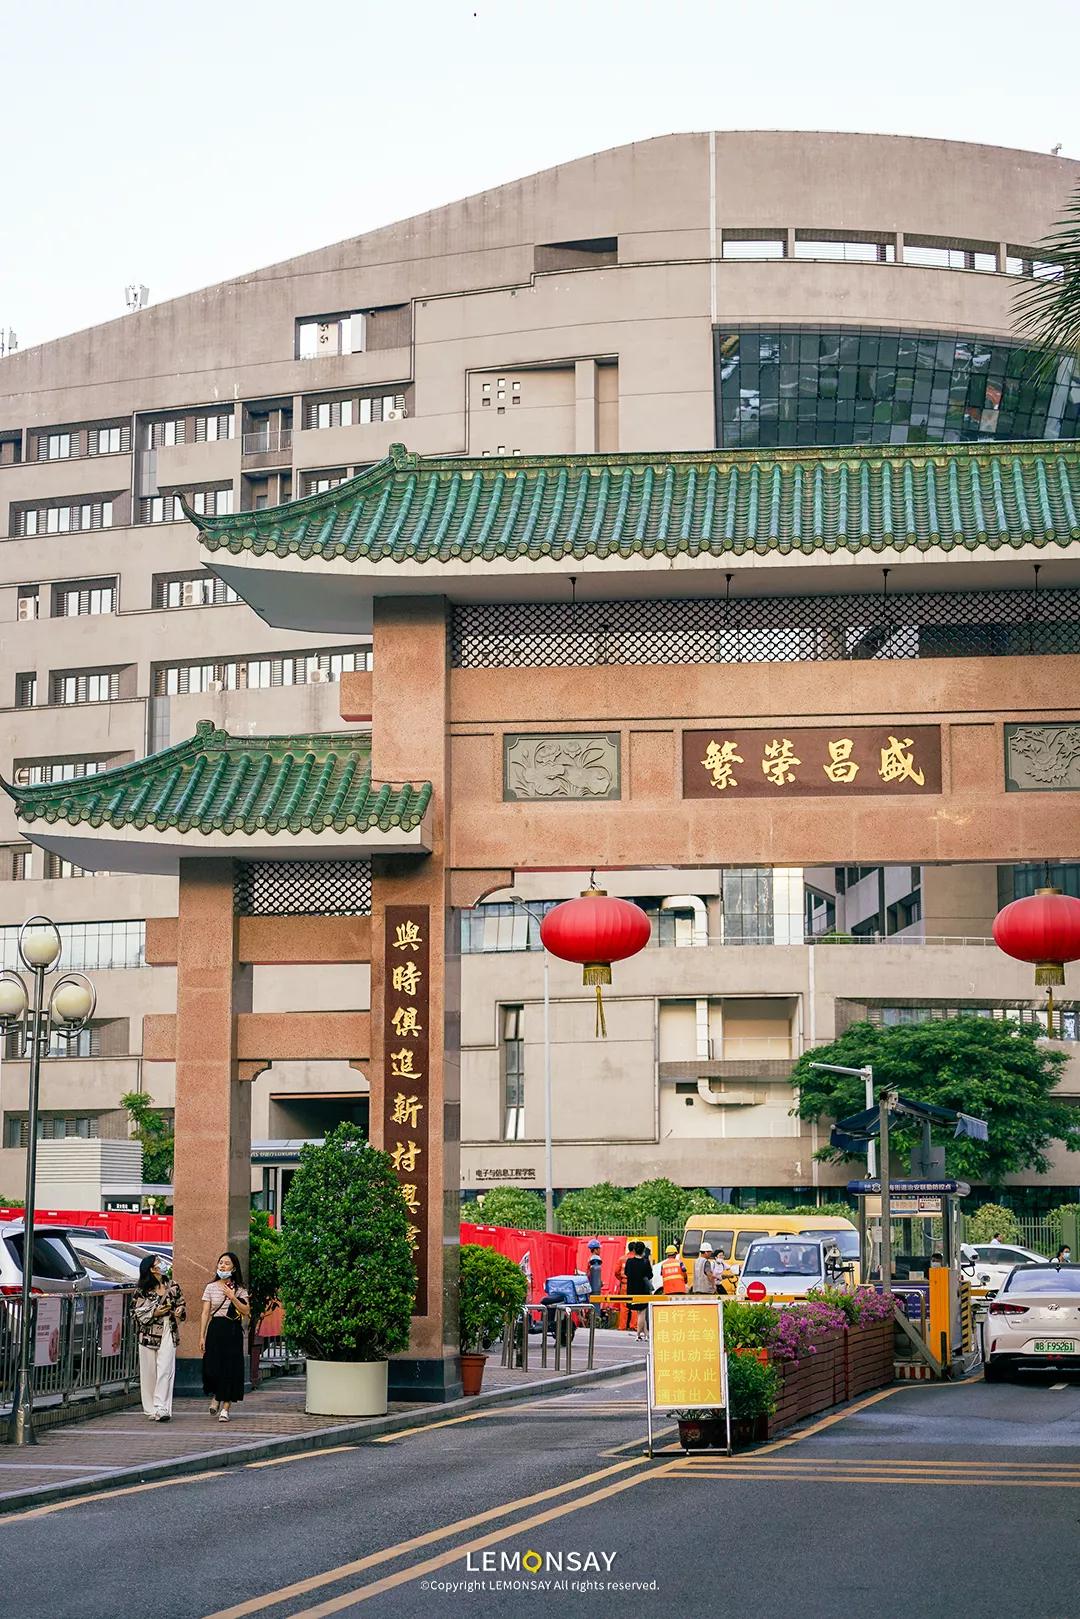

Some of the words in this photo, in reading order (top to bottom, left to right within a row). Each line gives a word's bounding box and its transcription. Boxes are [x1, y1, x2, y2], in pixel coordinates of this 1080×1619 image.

[701, 736, 925, 790] 繁榮昌盛
[390, 919, 423, 1300] 與時俱進新村興
[657, 1328, 716, 1343] 电动车等
[657, 1349, 717, 1363] 非机动车
[657, 1367, 717, 1383] 严禁从此
[657, 1388, 716, 1403] 通道出入
